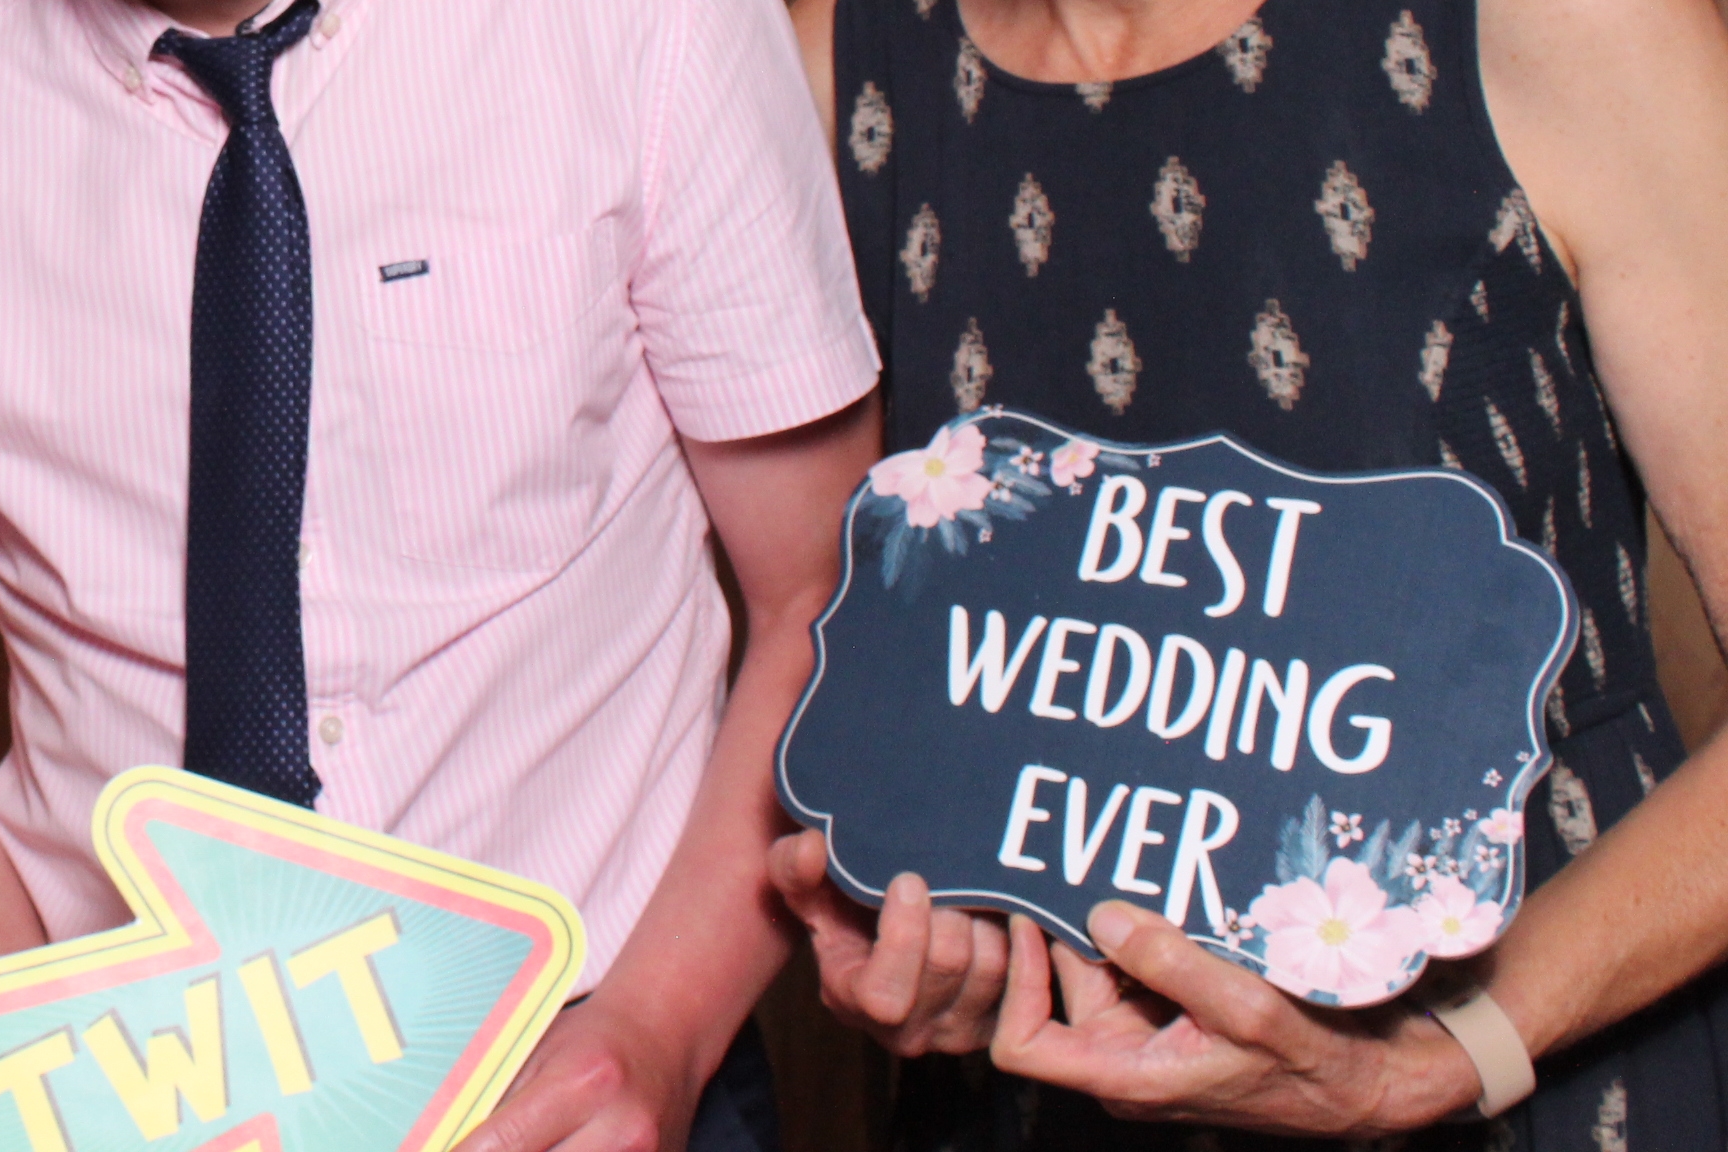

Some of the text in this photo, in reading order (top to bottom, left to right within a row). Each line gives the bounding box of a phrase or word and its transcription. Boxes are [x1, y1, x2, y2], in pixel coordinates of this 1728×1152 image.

[1078, 474, 1321, 617] BEST
[948, 605, 1395, 773] WEDDING
[998, 765, 1240, 928] EVER
